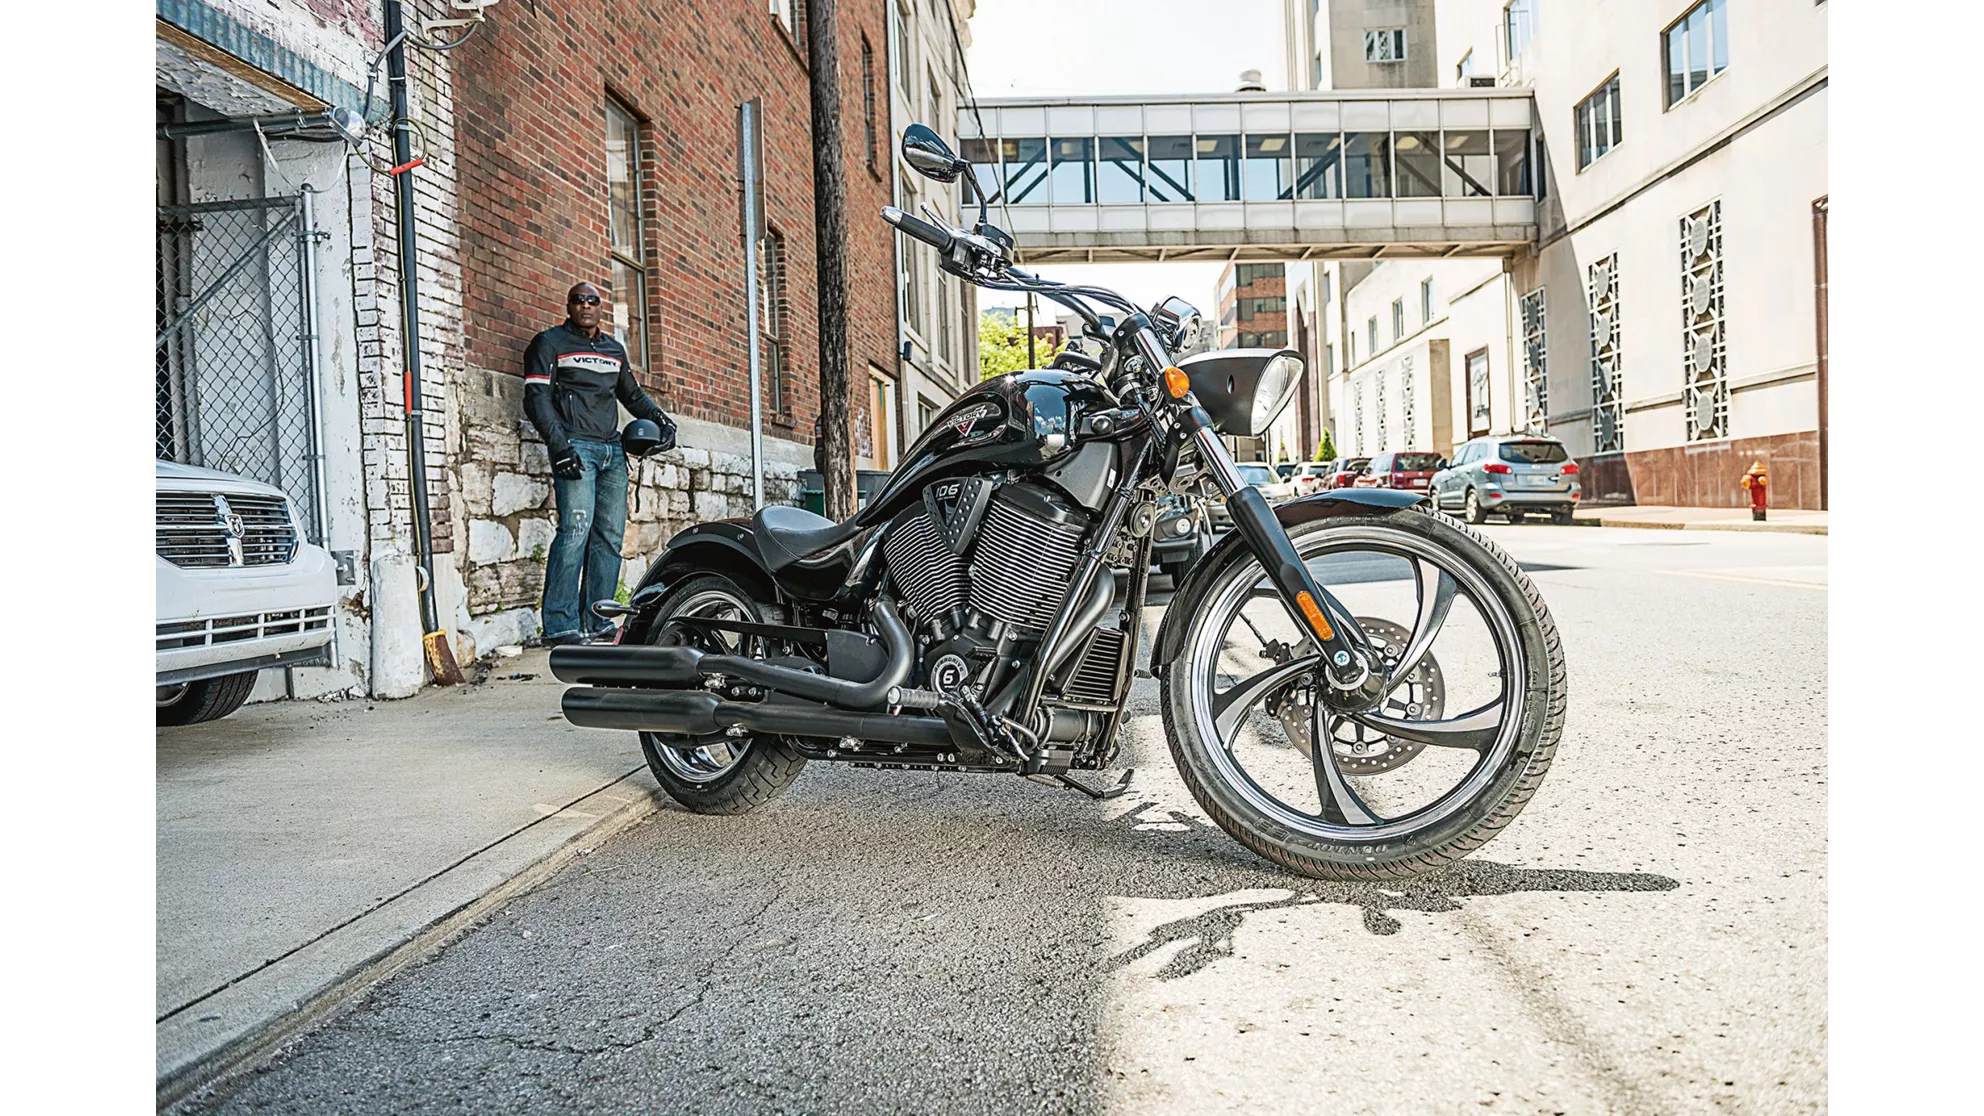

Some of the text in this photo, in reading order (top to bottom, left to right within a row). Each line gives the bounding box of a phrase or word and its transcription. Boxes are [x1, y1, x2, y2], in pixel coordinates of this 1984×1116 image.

[573, 357, 616, 367] VICTORY
[947, 408, 986, 428] VICTORY
[935, 483, 960, 498] 106
[943, 669, 955, 684] 6
